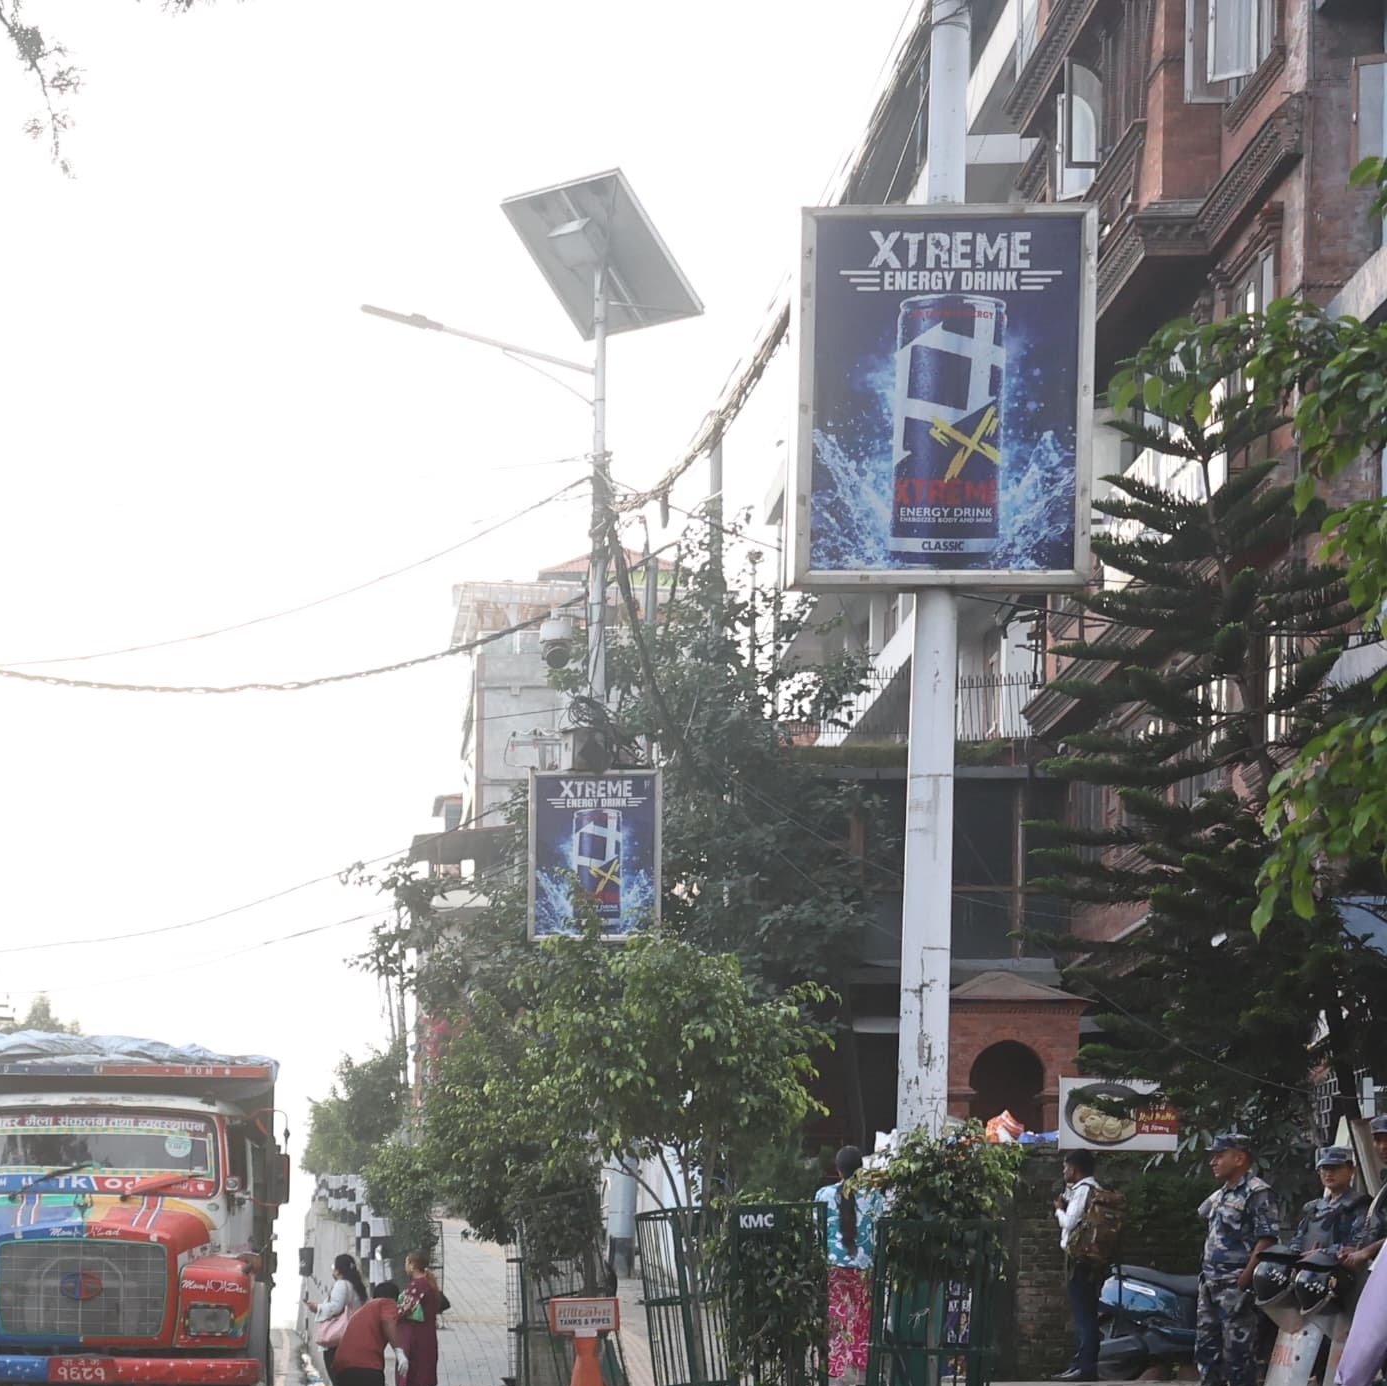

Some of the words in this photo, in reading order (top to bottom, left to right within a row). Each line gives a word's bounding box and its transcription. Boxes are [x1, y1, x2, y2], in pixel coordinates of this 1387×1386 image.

[868, 230, 1032, 269] XTREME
[884, 270, 955, 292] ENERGY
[960, 270, 1019, 291] DRINK
[899, 506, 951, 518] ENERGY
[953, 507, 994, 518] DRINK
[921, 541, 965, 552] CLASSIC
[559, 780, 633, 798] XTREME
[566, 798, 598, 809] ENERGY
[600, 798, 628, 808] DRINK
[25, 1114, 53, 1128] मैला
[109, 1117, 135, 1129] तथा
[739, 1213, 775, 1229] KMC
[560, 1318, 582, 1326] TANKS
[590, 1317, 611, 1325] PIPES
